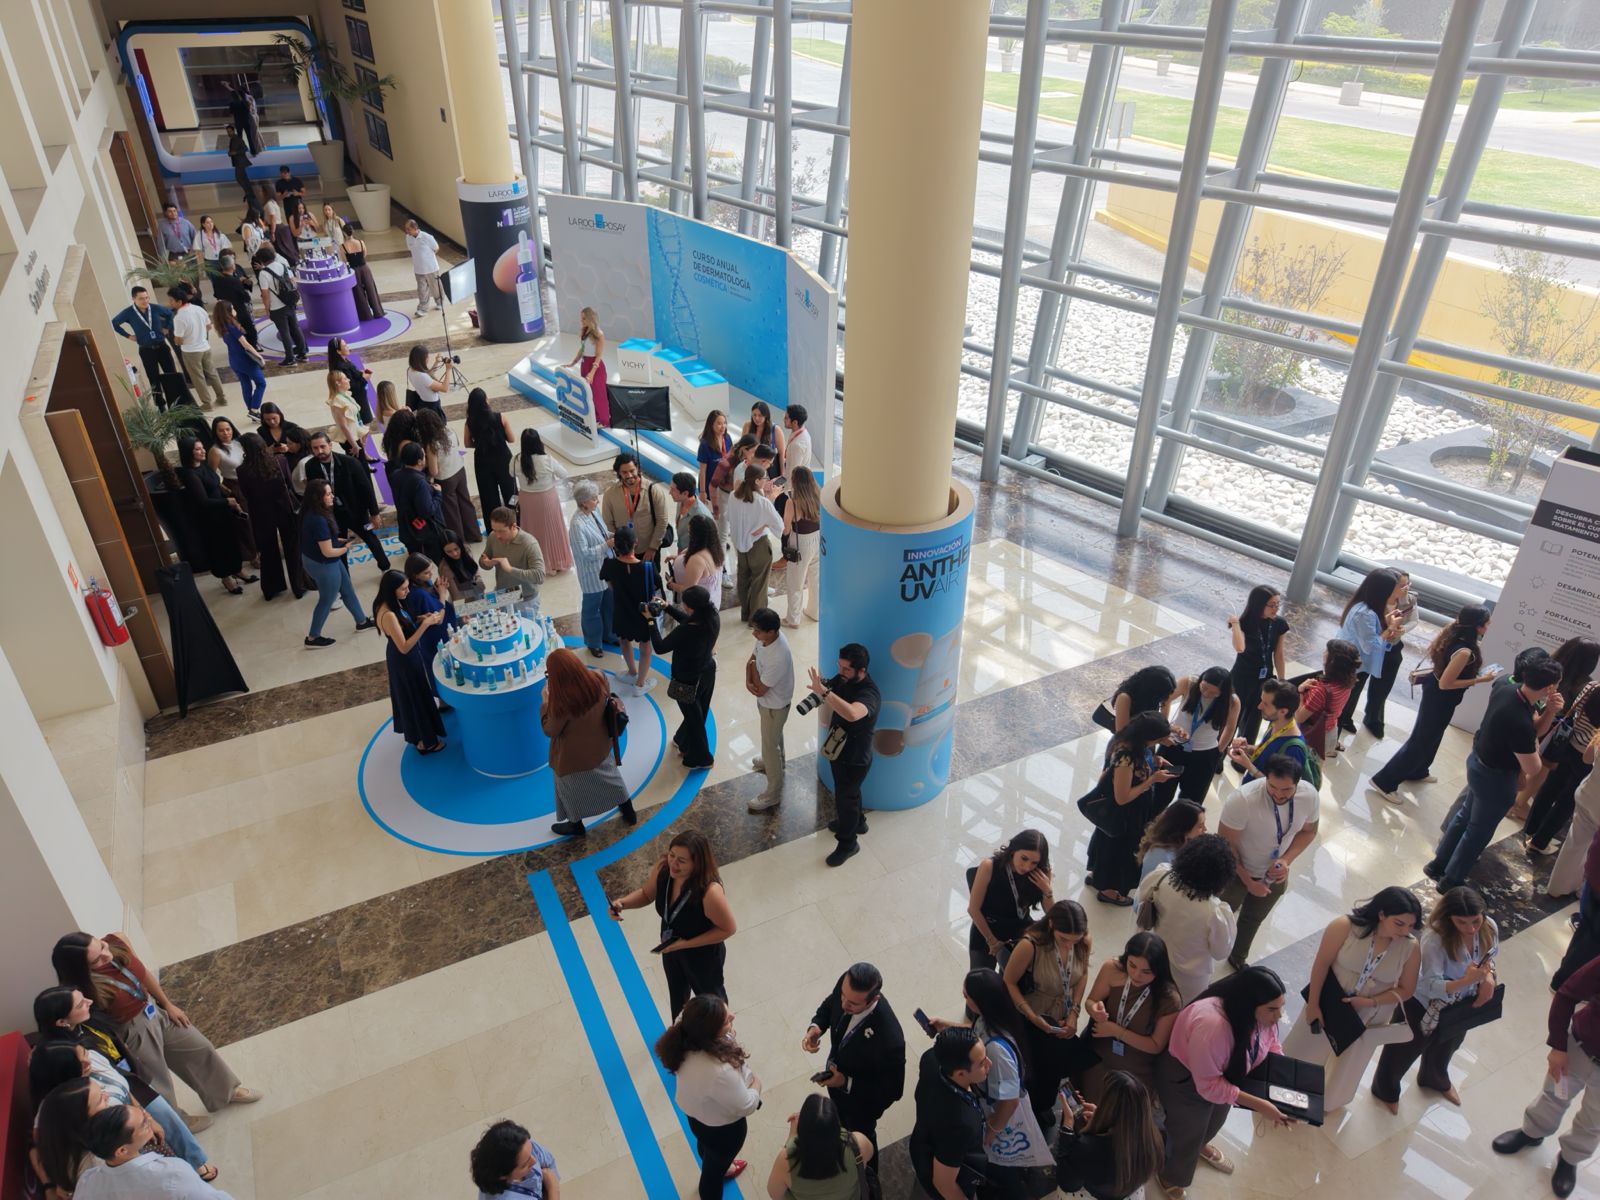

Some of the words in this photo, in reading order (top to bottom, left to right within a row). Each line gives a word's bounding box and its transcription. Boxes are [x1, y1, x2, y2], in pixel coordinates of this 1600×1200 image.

[692, 250, 716, 265] CURSO
[716, 259, 739, 275] ANUAL
[693, 261, 702, 272] DE
[621, 360, 645, 370] VICHY
[1552, 515, 1577, 527] SOBRE
[1577, 521, 1587, 530] EL
[1555, 508, 1593, 524] DESCUBRA
[1551, 520, 1600, 539] TRATAMIENTO
[907, 539, 962, 560] INNOVACIÓN
[1544, 609, 1593, 630] FORTALEZCA
[1536, 629, 1568, 643] DESCUB
